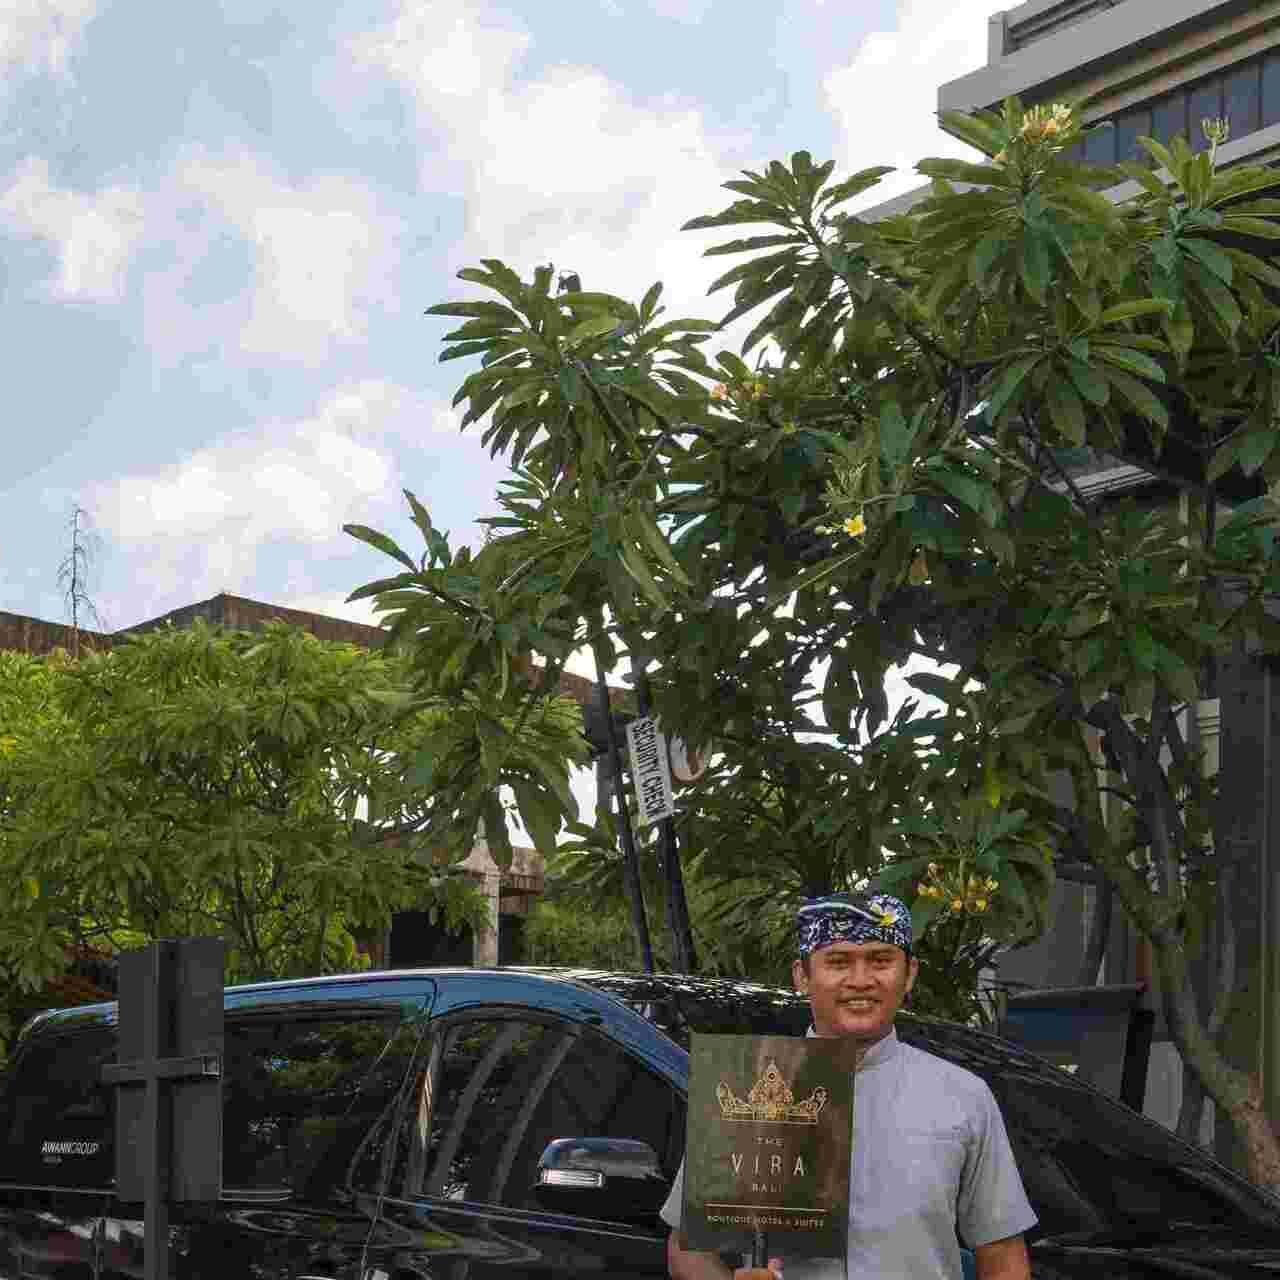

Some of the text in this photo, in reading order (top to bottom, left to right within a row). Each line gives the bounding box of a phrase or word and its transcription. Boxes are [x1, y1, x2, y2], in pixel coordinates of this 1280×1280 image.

[631, 719, 659, 776] SECURITY
[754, 1137, 784, 1147] THE
[731, 1153, 806, 1176] VIRA
[752, 1183, 783, 1193] BALI
